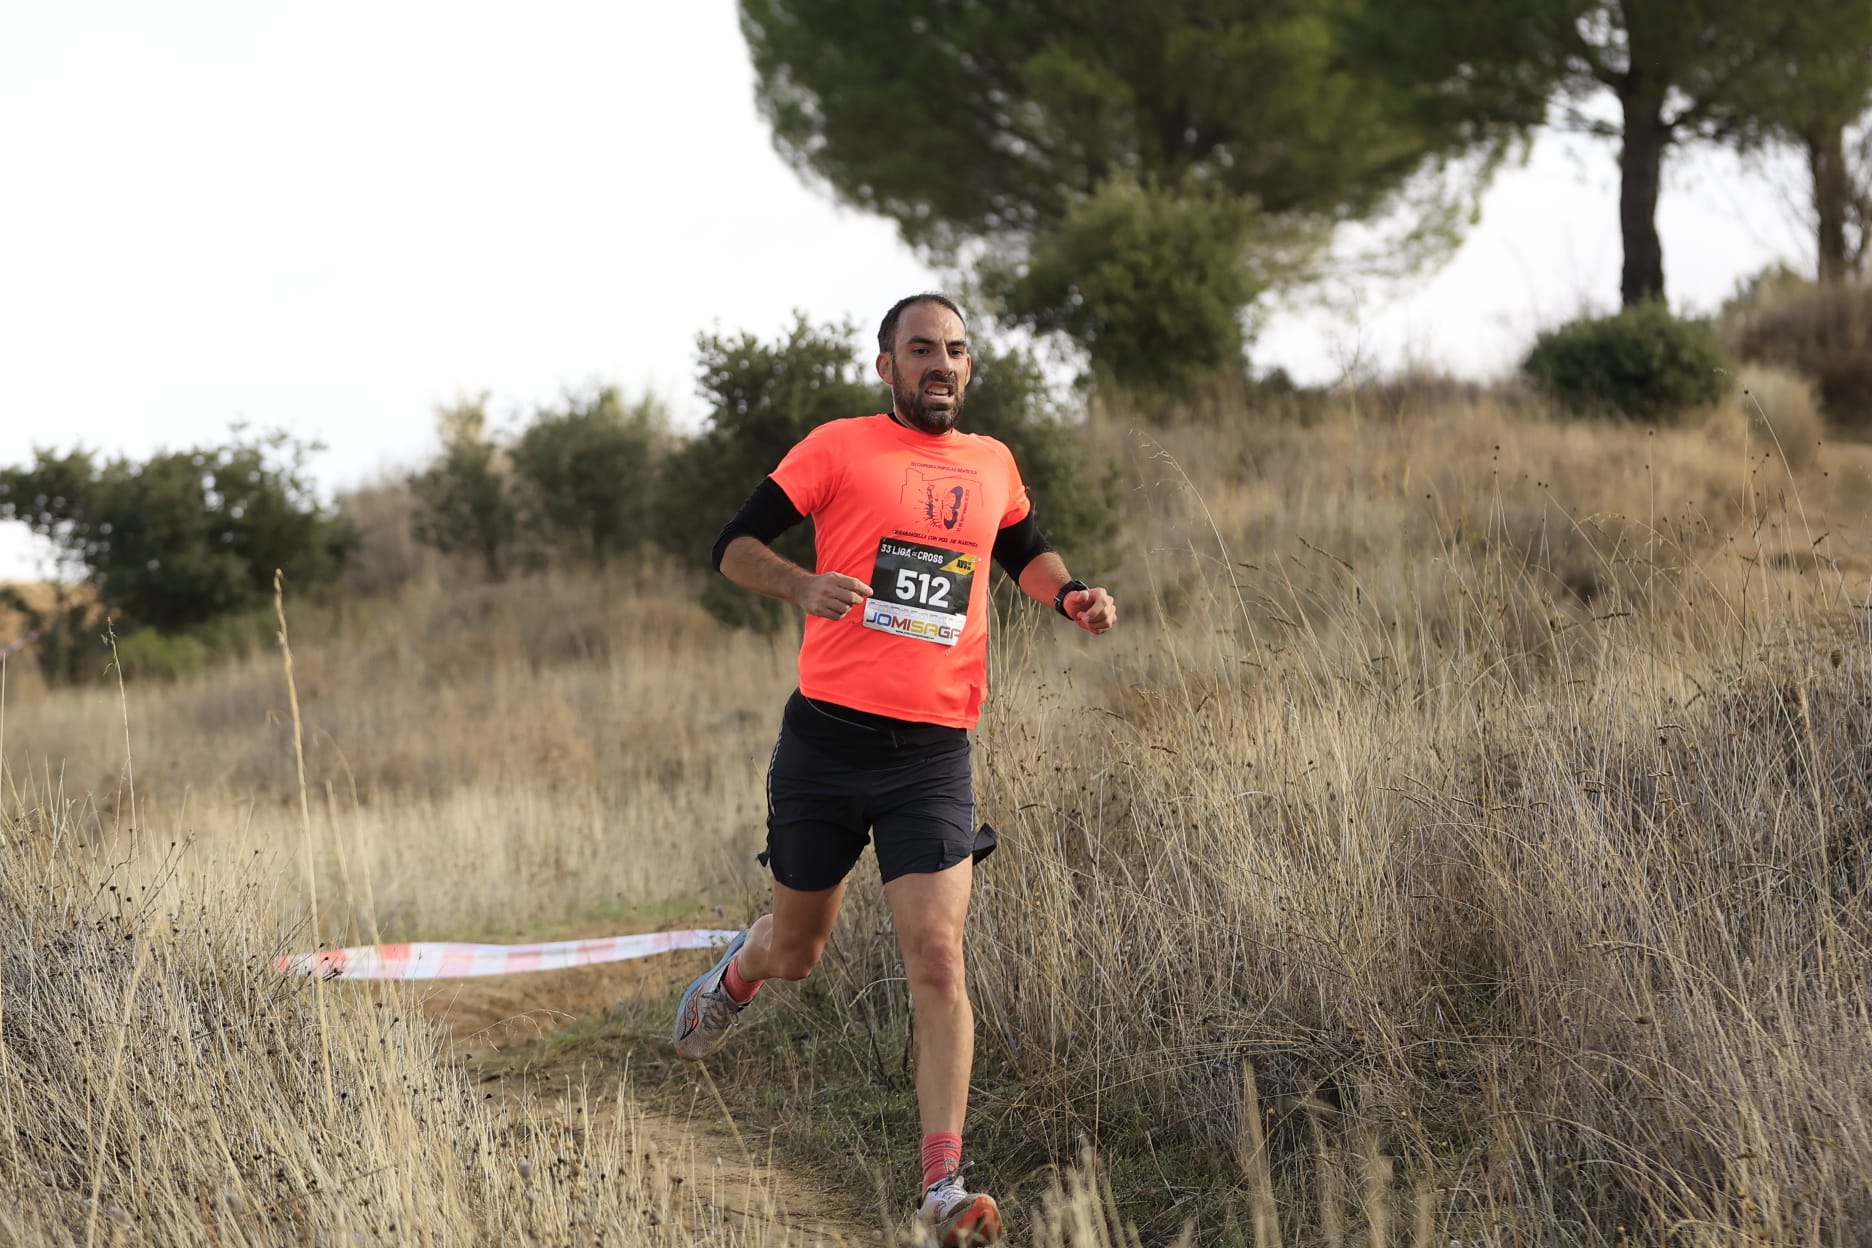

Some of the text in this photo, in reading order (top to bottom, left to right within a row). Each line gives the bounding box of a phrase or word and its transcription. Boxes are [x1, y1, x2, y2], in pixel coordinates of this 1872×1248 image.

[881, 543, 892, 553] 33
[892, 545, 911, 558] LIGA
[917, 551, 943, 564] CROSS
[895, 568, 951, 608] 512
